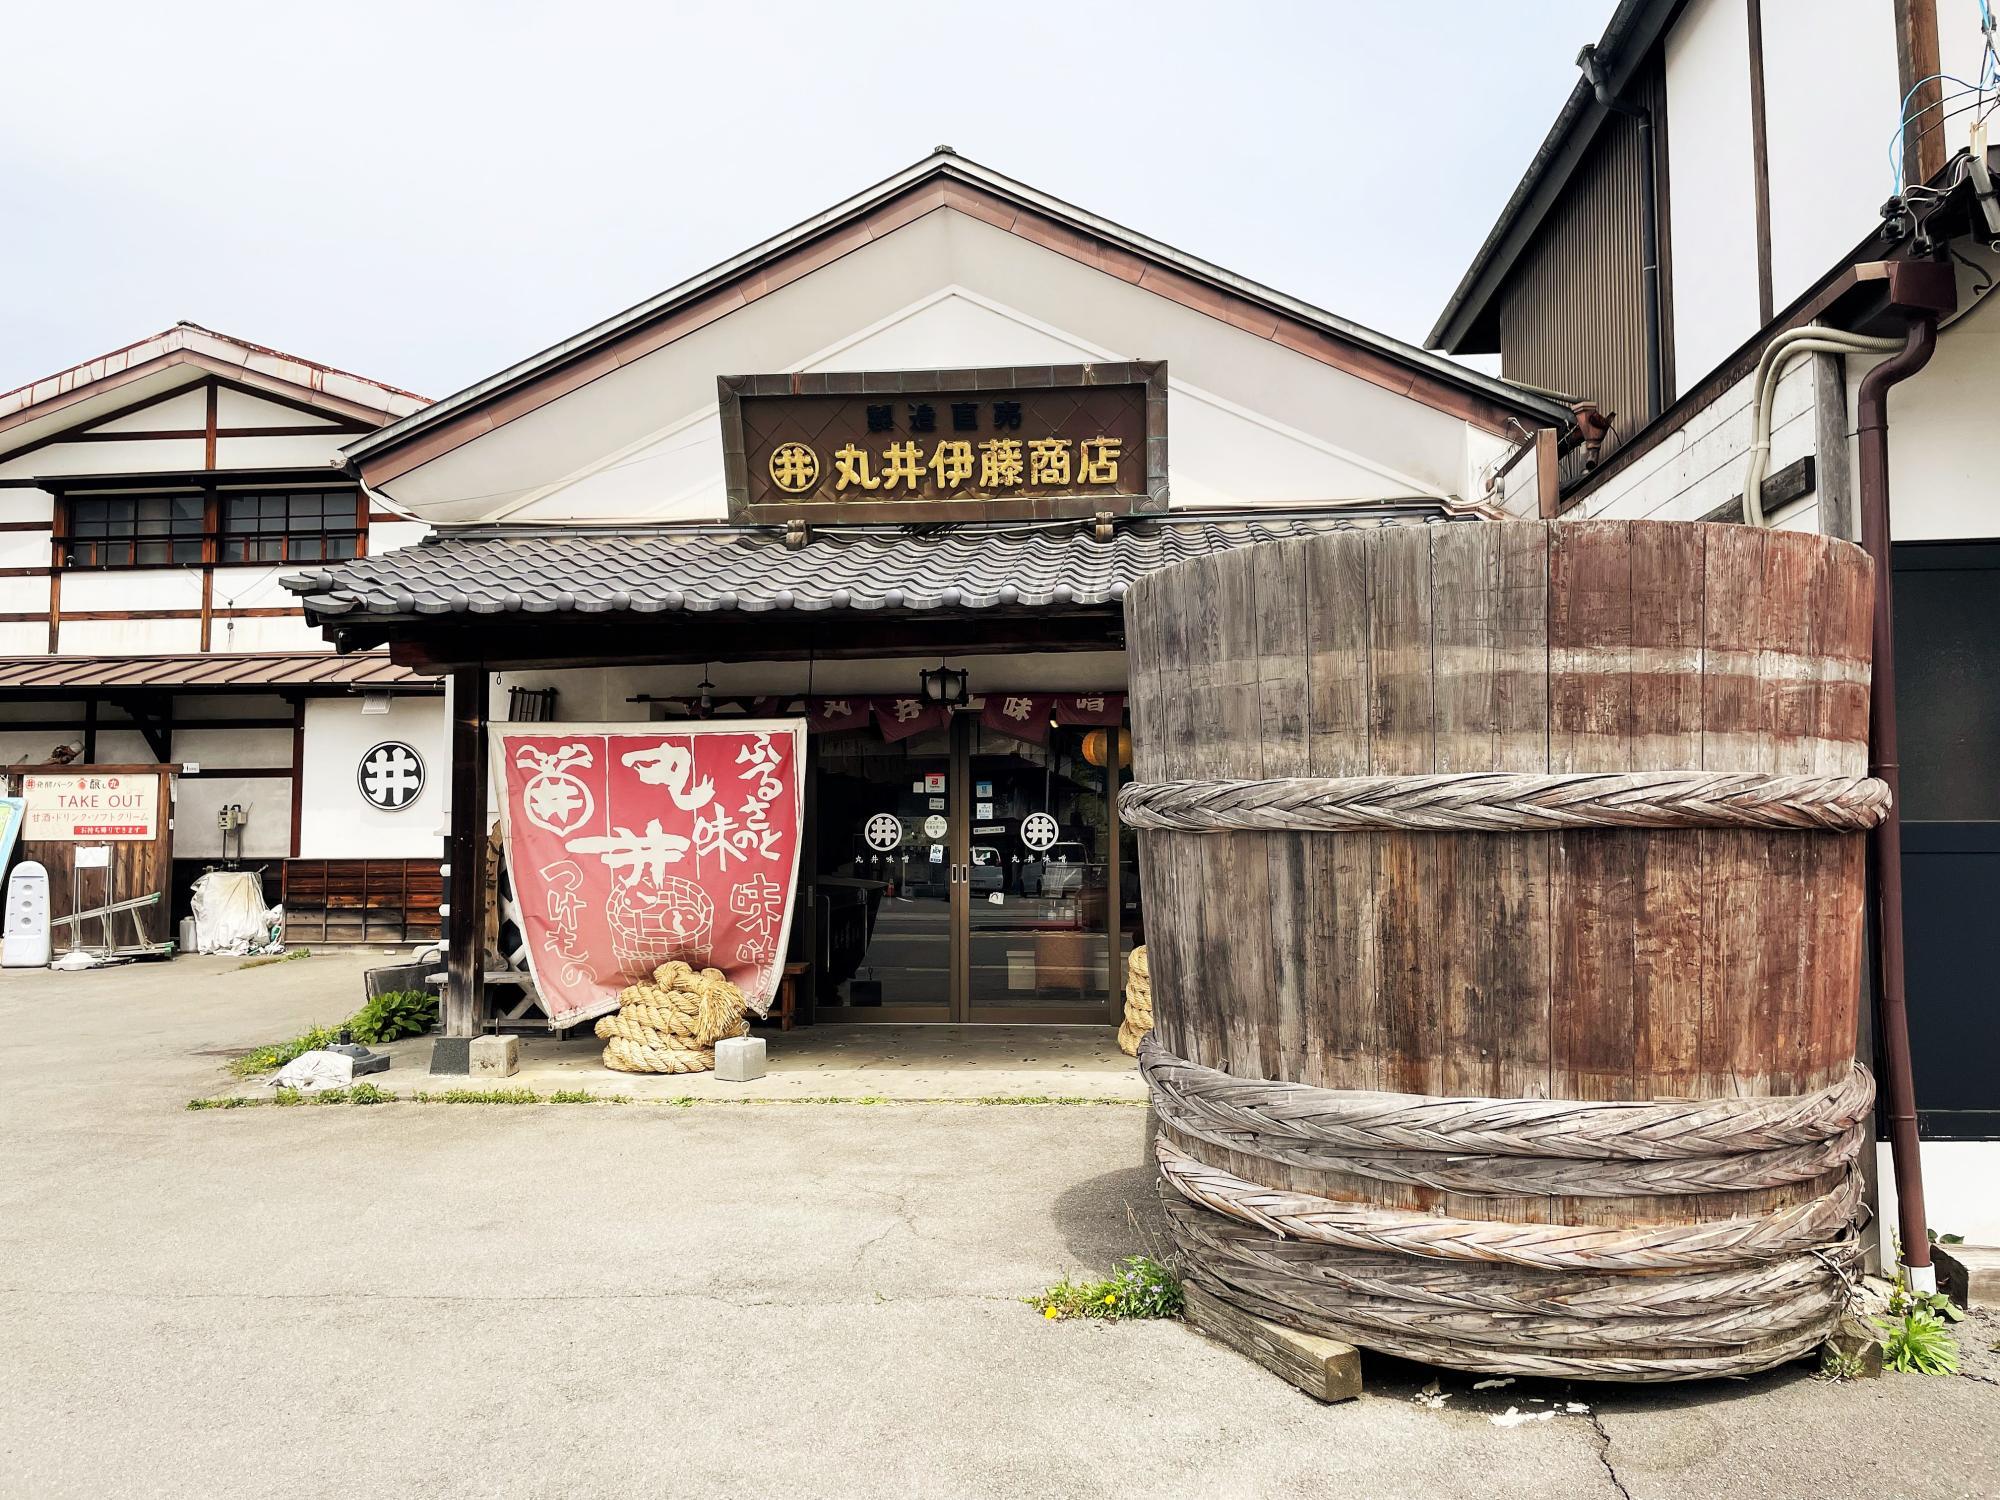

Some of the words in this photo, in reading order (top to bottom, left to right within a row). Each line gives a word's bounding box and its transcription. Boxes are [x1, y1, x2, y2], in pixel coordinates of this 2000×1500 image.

[775, 447, 813, 487] 井
[834, 436, 1123, 490] 丸井伊藤商店
[365, 747, 420, 806] 井
[58, 795, 99, 807] TAKE
[108, 794, 144, 807] OUT
[564, 742, 717, 892] 丸井
[80, 826, 141, 834] お持ち帰りできます
[870, 818, 897, 846] 井
[1026, 817, 1054, 846] 井
[539, 860, 597, 987] つけもの
